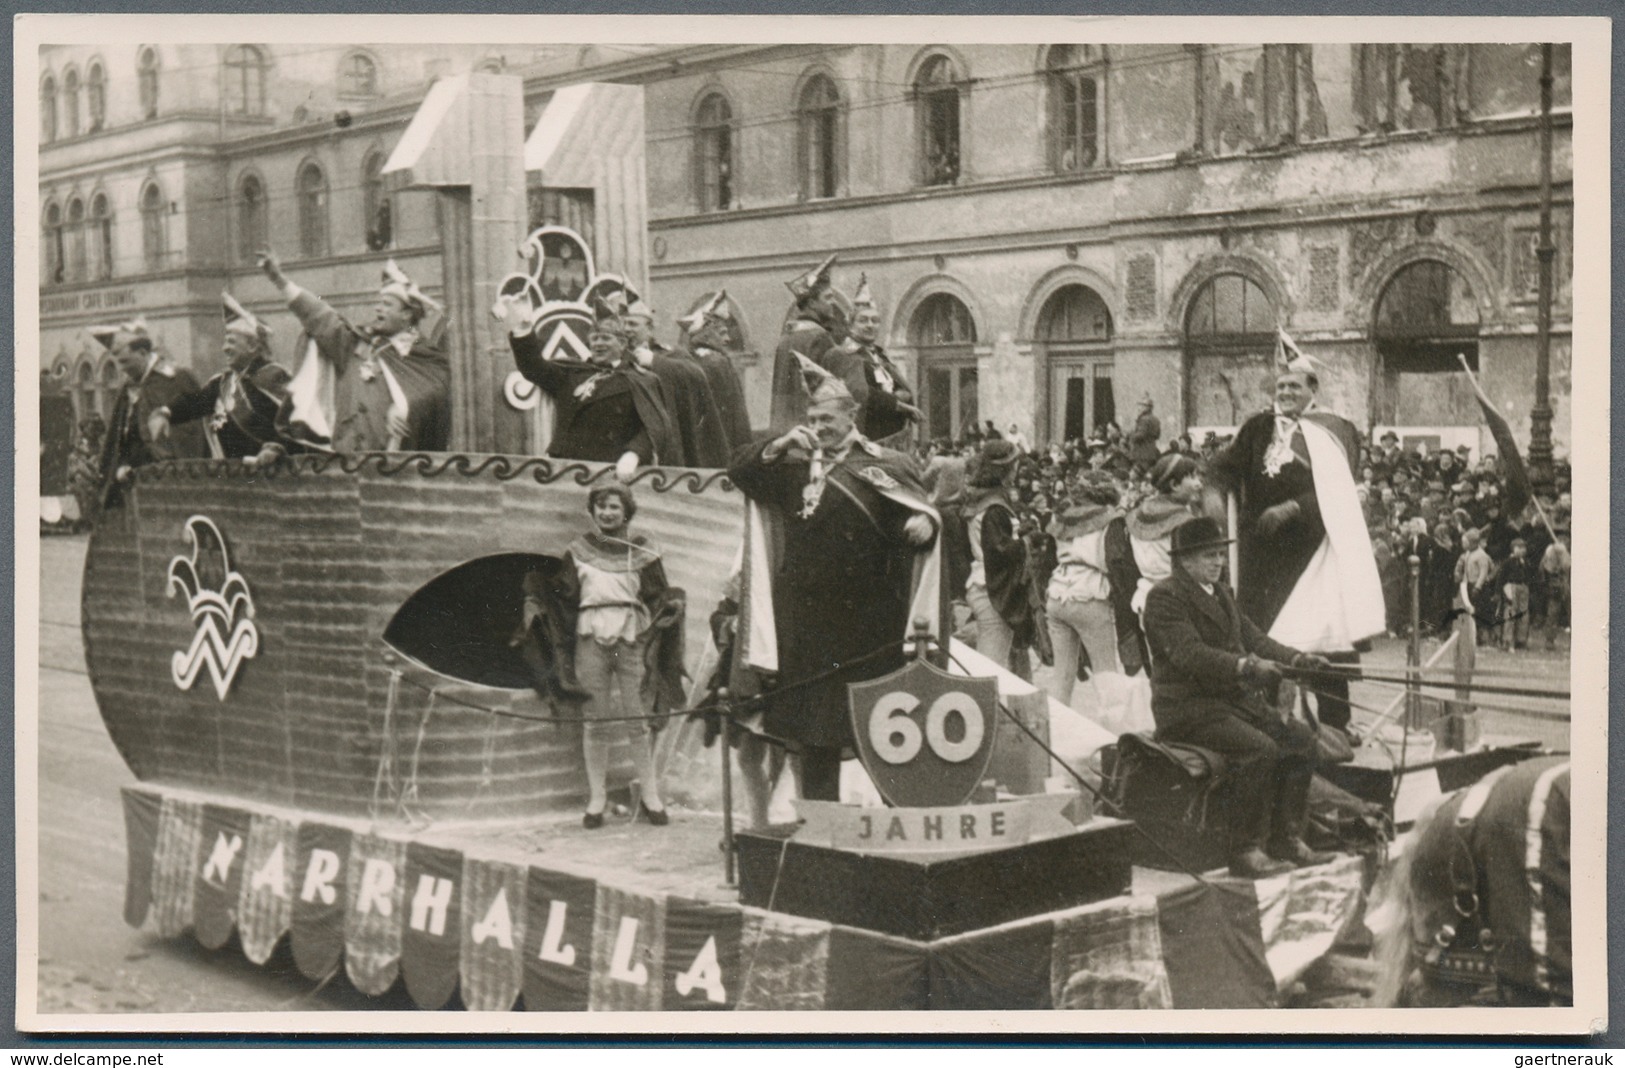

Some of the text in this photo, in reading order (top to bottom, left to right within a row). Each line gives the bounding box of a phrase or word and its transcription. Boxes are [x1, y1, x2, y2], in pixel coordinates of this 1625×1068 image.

[868, 691, 984, 764] 60
[859, 811, 1006, 841] JAHRE
[203, 831, 726, 1004] NARRHALLA
